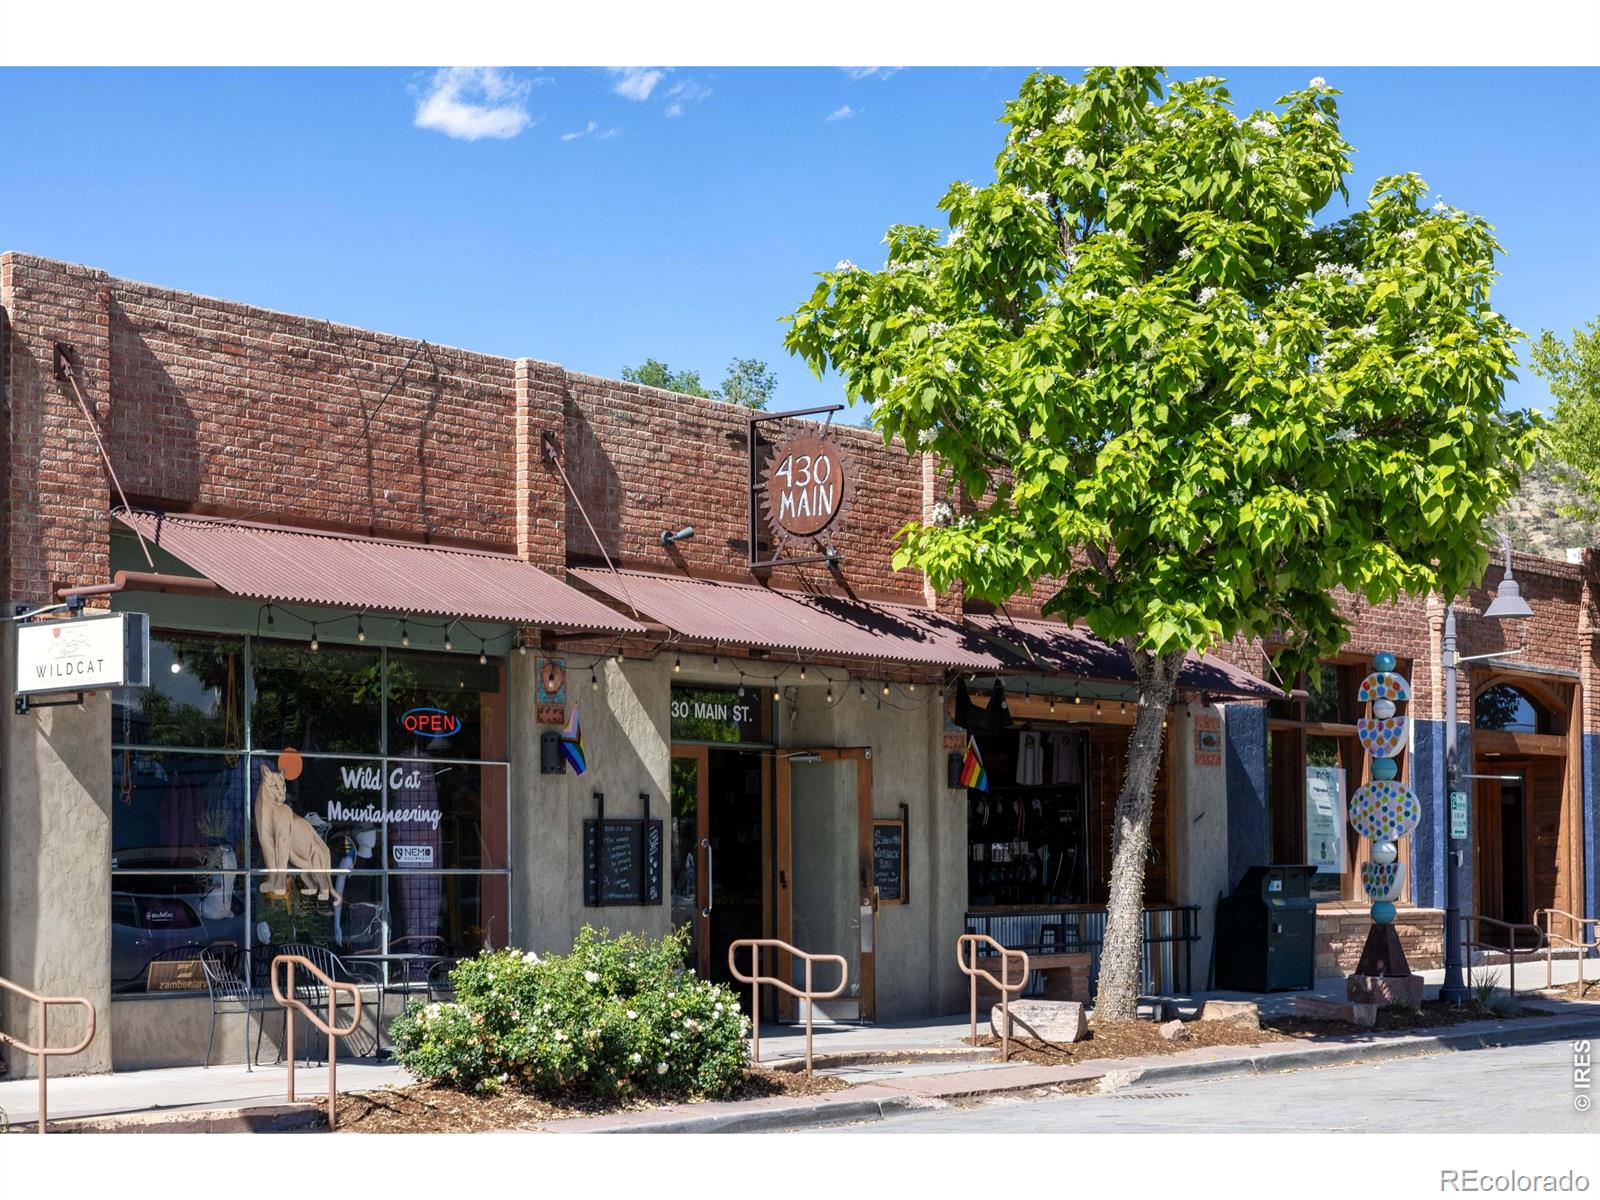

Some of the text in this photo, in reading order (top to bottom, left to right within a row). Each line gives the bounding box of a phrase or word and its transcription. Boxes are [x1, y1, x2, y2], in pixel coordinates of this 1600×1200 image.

[775, 455, 831, 488] 430
[779, 484, 834, 520] MAIN
[36, 659, 104, 678] WILDCAT
[404, 715, 456, 731] OPEN
[694, 703, 728, 720] MAIN
[732, 705, 753, 722] ST.
[341, 766, 421, 790] Wild Cat
[327, 800, 443, 831] Mountaineering
[404, 848, 431, 856] NEMO
